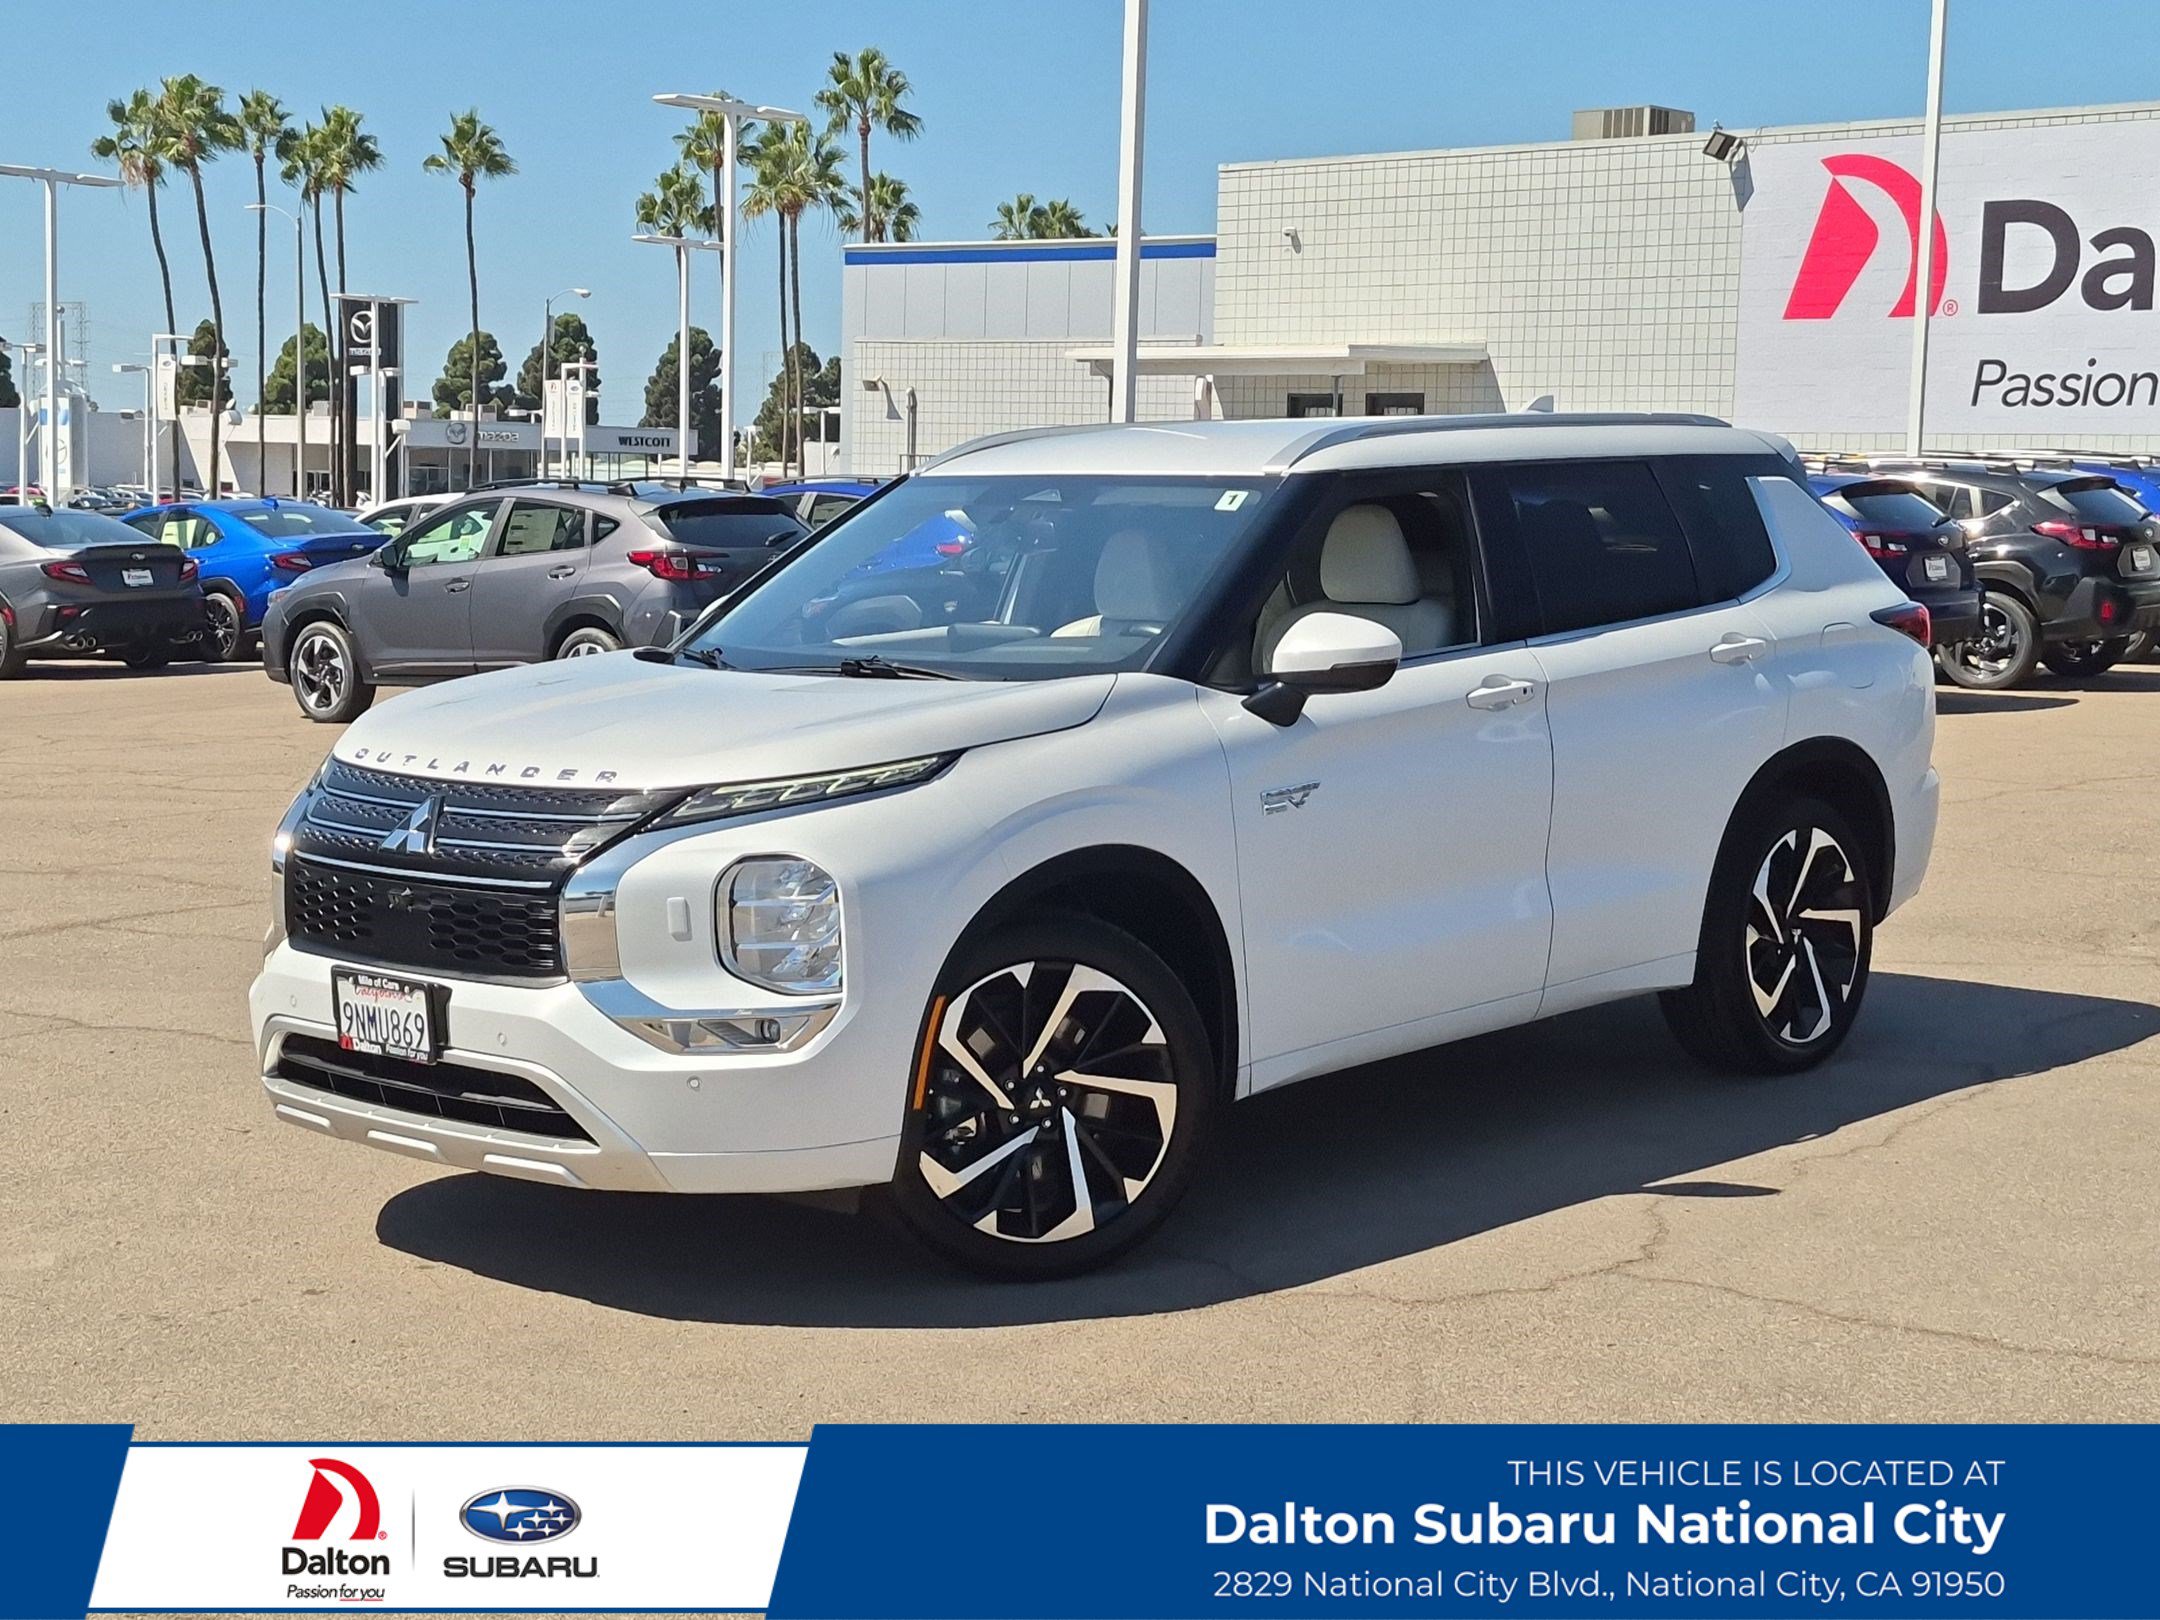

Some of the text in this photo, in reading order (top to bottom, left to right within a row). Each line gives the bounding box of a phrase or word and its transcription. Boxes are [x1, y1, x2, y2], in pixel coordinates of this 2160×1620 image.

[349, 347, 382, 356] maz
[1971, 357, 2159, 407] Passion
[478, 430, 519, 443] mazda
[618, 436, 671, 448] WESTCOTT
[355, 747, 618, 783] OUTLANDER
[343, 1001, 425, 1049] 9NMU869
[353, 1038, 382, 1055] Dalton
